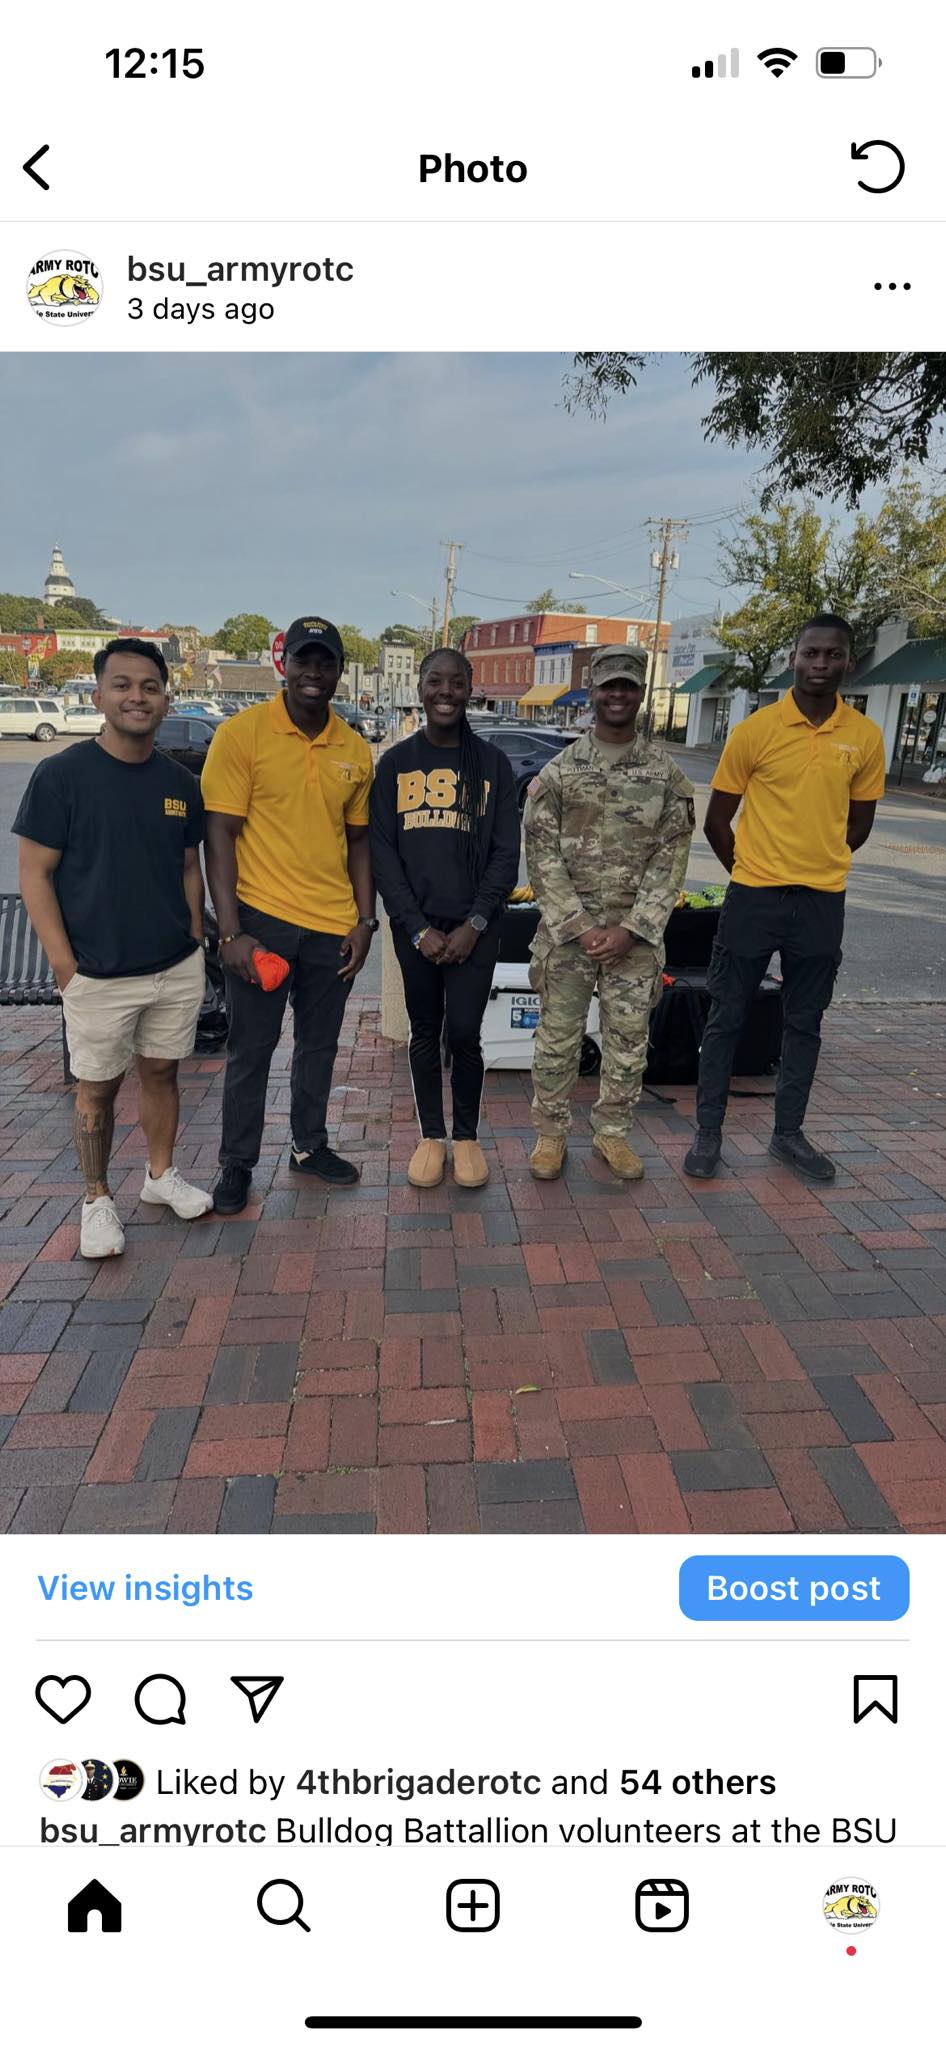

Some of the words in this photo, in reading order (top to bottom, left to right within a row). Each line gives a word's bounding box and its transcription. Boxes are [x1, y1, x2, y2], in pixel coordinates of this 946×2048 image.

[106, 48, 204, 79] 12:15
[420, 153, 527, 183] Photo
[128, 254, 354, 288] bsu_armyrotc
[128, 298, 143, 319] 3
[153, 297, 214, 325] days
[225, 303, 275, 325] ago
[645, 770, 664, 778] ARMY
[164, 798, 187, 811] BSU
[512, 1010, 522, 1021] 5
[38, 1574, 115, 1601] View
[126, 1574, 253, 1607] insights
[708, 1575, 799, 1601] Boost
[810, 1576, 881, 1607] post
[157, 1768, 238, 1795] Liked
[249, 1768, 286, 1801] by
[296, 1767, 541, 1801] 4thbrigaderotc
[551, 1768, 608, 1795] and
[620, 1769, 663, 1796] 54
[672, 1768, 777, 1796] others
[40, 1817, 266, 1846] bsu_armyrotc
[277, 1817, 393, 1846] Bulldog
[404, 1817, 548, 1844] Battallion
[558, 1817, 721, 1844] volunteers
[731, 1819, 761, 1844] at
[770, 1817, 821, 1844] the
[832, 1817, 896, 1844] BSU
